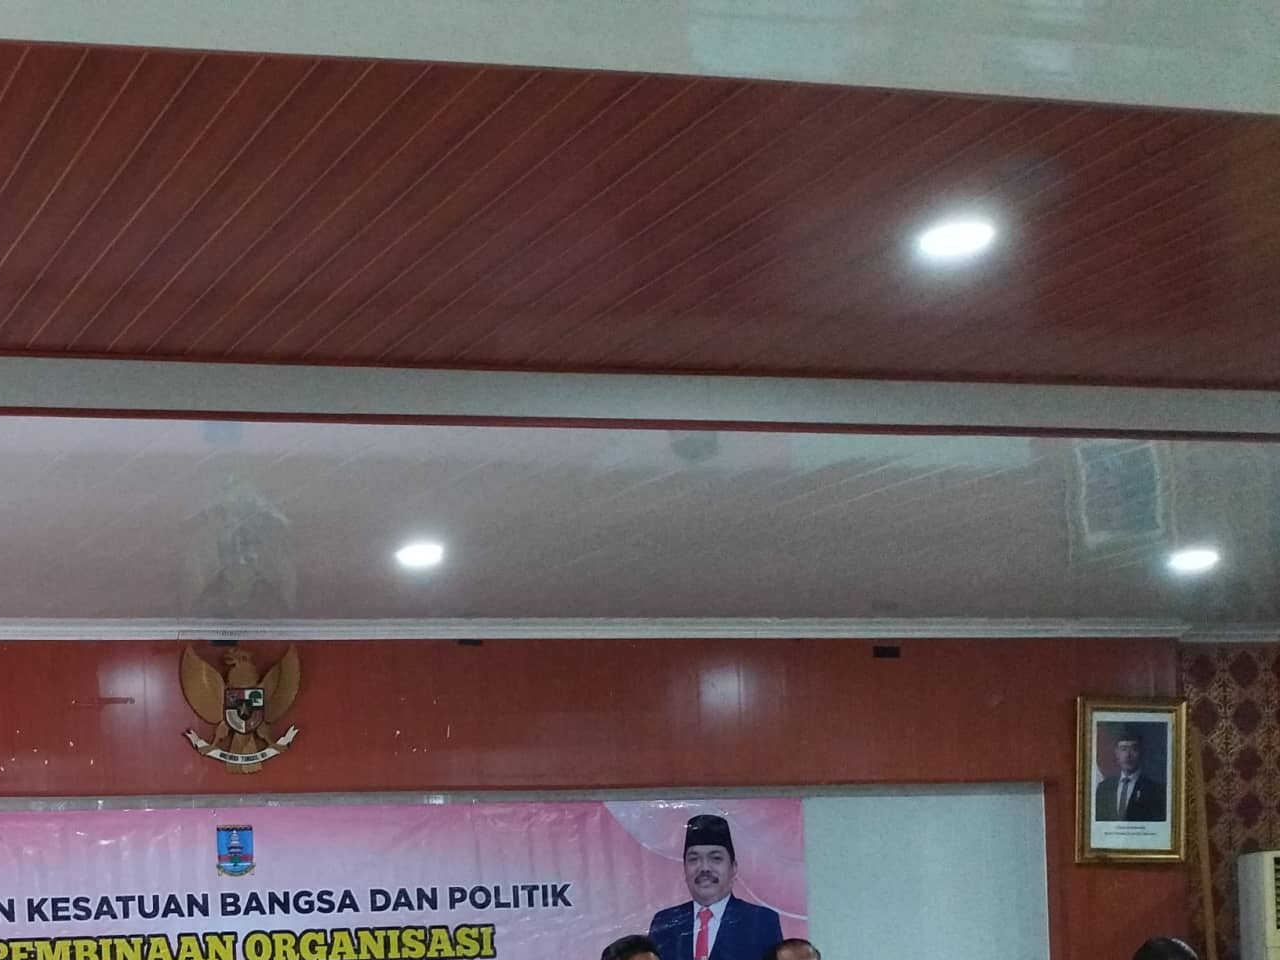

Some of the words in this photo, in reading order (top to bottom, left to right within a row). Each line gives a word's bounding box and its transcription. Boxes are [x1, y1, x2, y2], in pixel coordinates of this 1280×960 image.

[26, 893, 210, 922] KESATUAN
[220, 889, 360, 917] BANGSA
[369, 886, 438, 912] DAN
[448, 883, 573, 910] POLITIK
